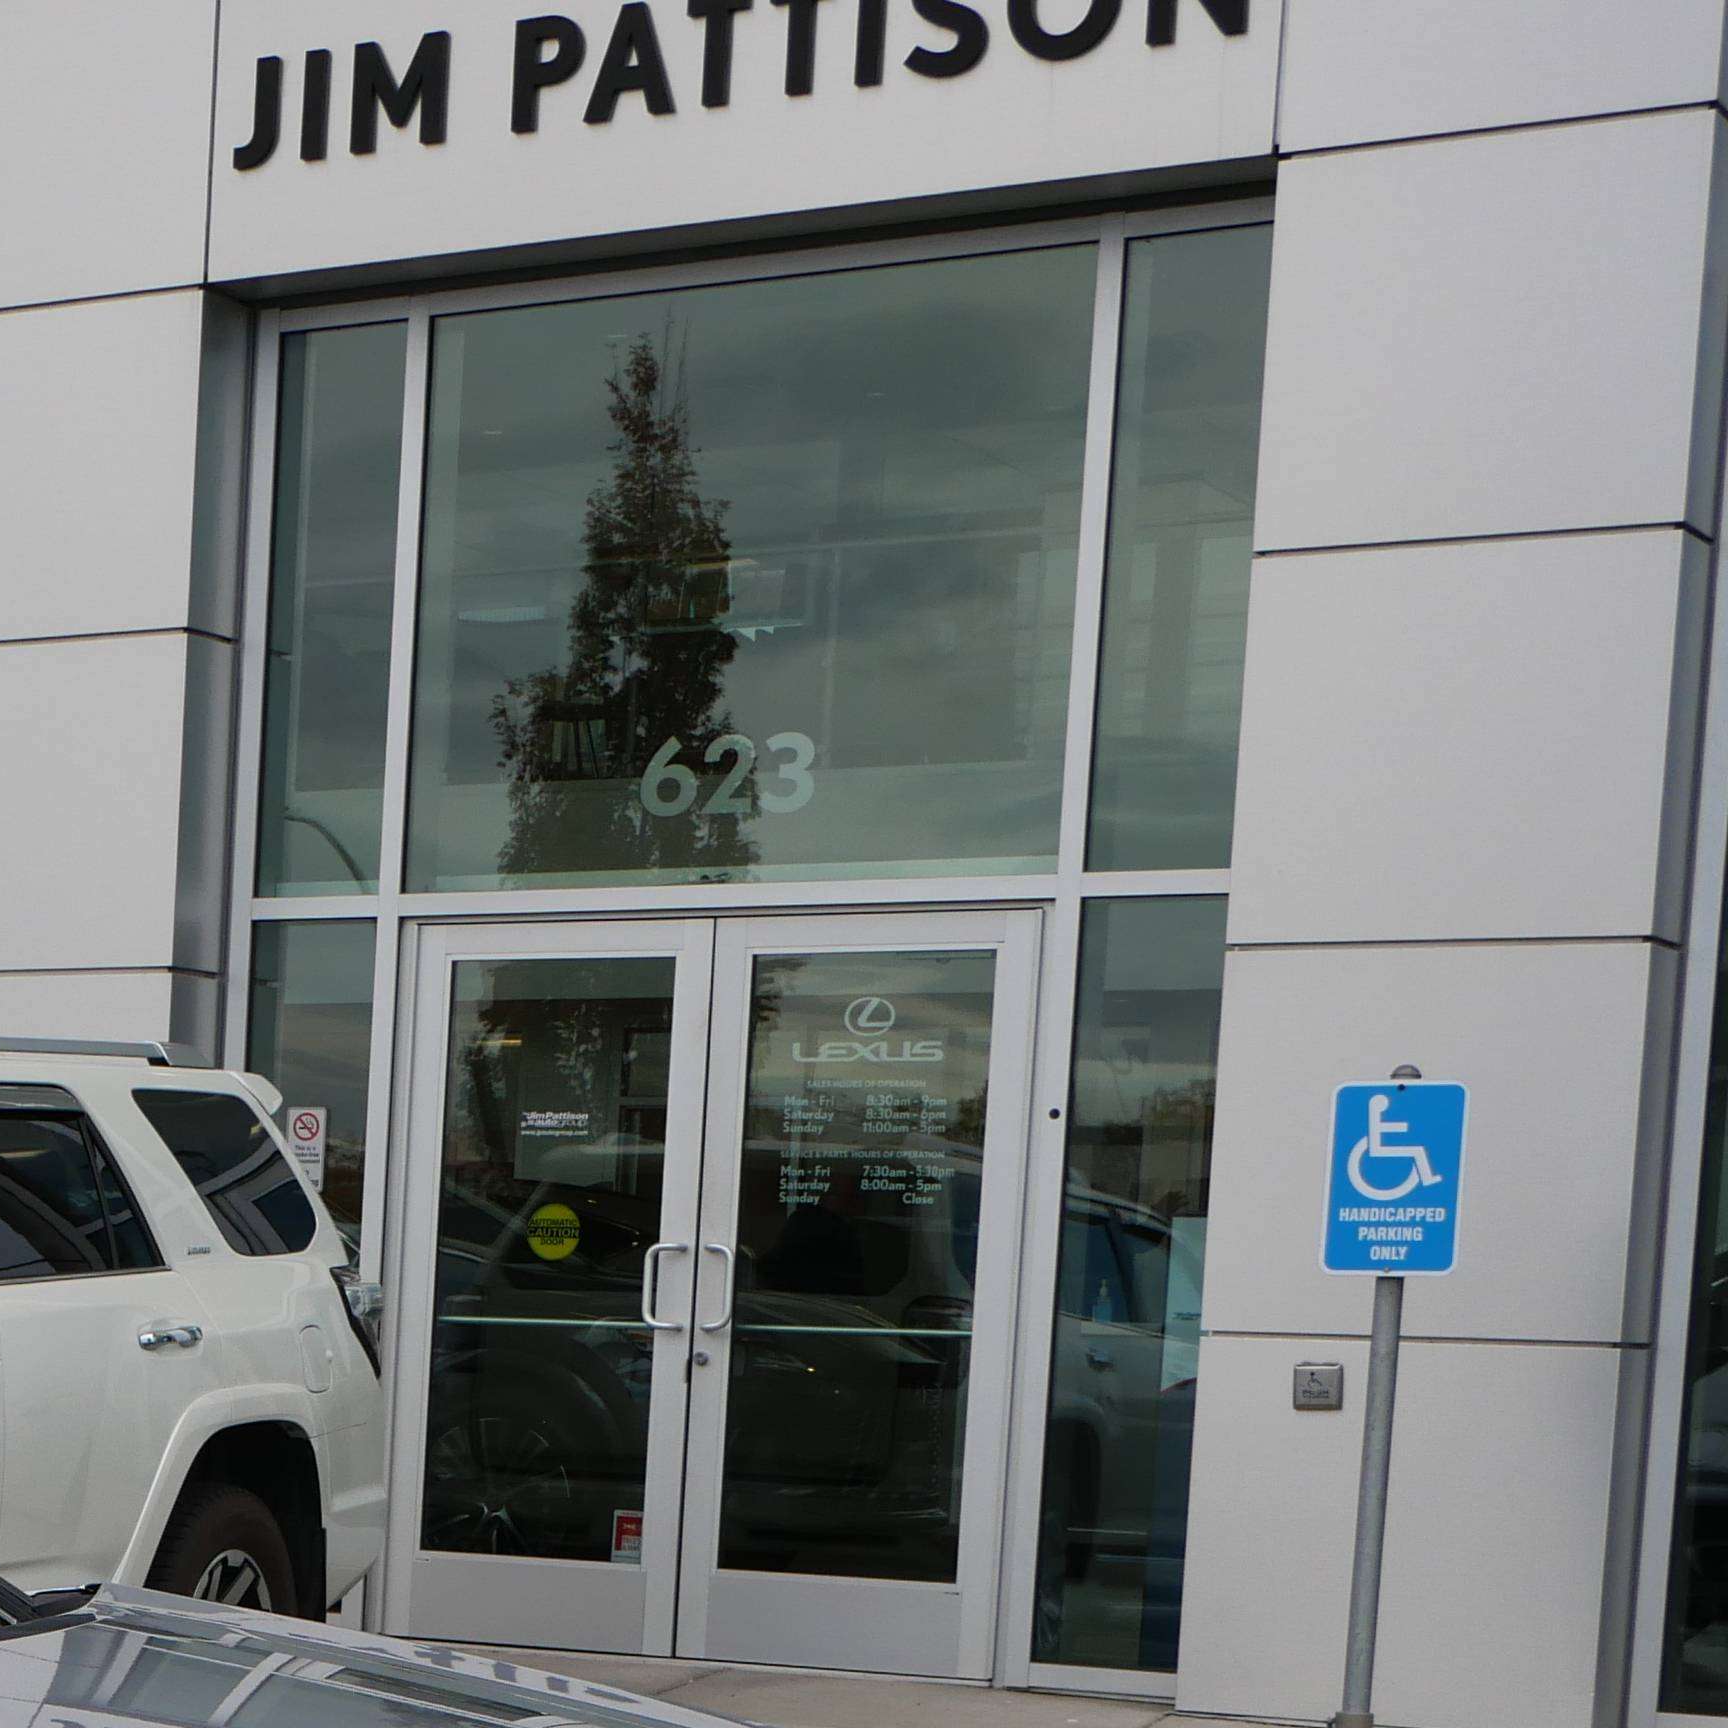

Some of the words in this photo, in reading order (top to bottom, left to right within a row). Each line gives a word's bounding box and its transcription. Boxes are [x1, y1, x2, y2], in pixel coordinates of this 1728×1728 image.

[233, 31, 451, 171] JIM
[640, 731, 815, 817] 623
[793, 1041, 944, 1062] LEXUS
[784, 1095, 808, 1106] Mon
[819, 1095, 835, 1106] Fri
[866, 1095, 911, 1106] 8:30am
[922, 1095, 947, 1109] 9pm
[784, 1108, 834, 1122] Saturday
[865, 1108, 910, 1120] 8:30am
[921, 1109, 946, 1122] 6pm
[783, 1122, 824, 1135] Sunday
[863, 1122, 910, 1133] 11:00am
[920, 1122, 945, 1136] 5pm
[780, 1166, 804, 1177] Mon
[815, 1166, 831, 1177] Fri
[862, 1165, 907, 1178] 7:30am
[779, 1179, 830, 1193] Saturday
[860, 1179, 906, 1191] 8:00am
[916, 1180, 942, 1194] 5pm
[779, 1192, 820, 1206] Sunday
[1338, 1207, 1446, 1223] HANDICAPPED
[528, 1228, 579, 1238] CAUTION
[1358, 1226, 1423, 1241] PARKING
[1369, 1246, 1407, 1261] ONLY
